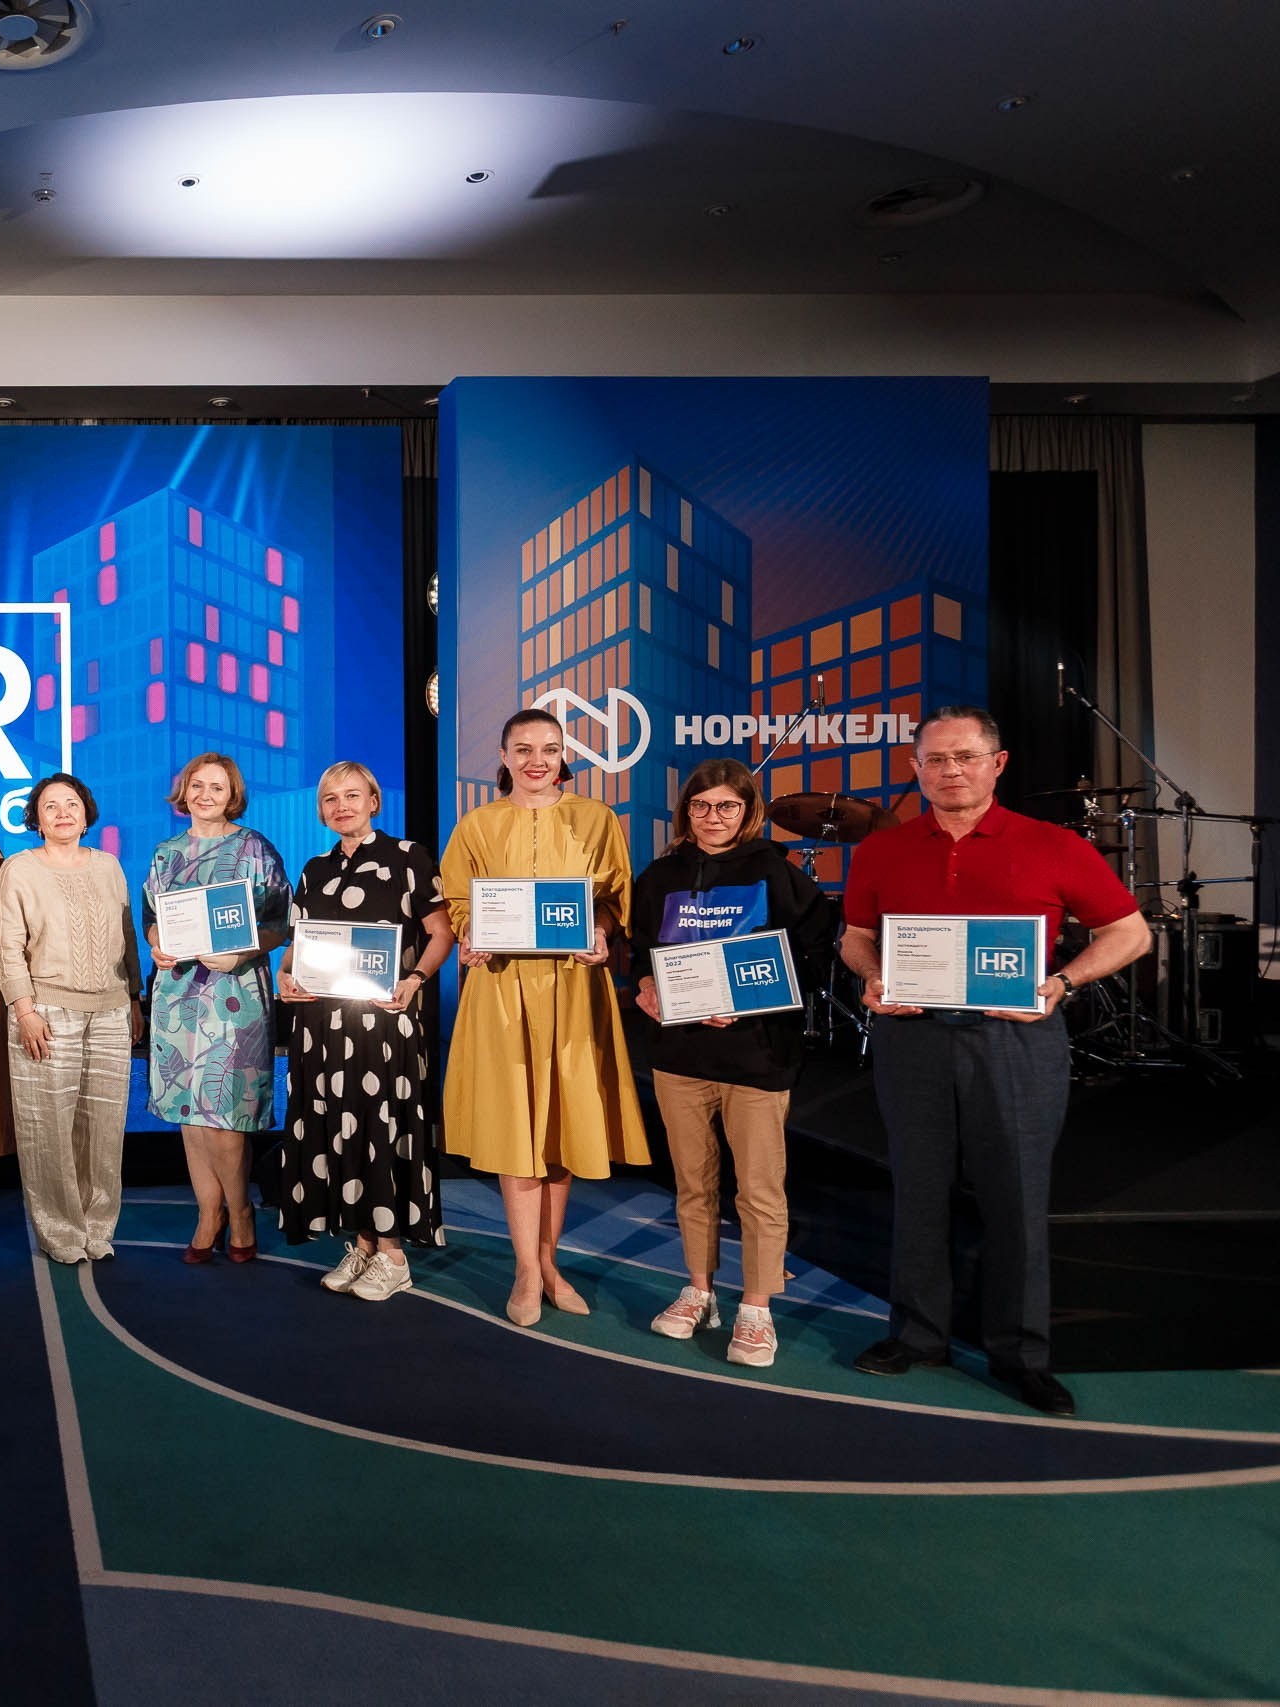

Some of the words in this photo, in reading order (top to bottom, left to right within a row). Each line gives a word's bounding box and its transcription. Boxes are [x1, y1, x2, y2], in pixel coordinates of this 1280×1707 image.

[675, 713, 918, 745] НОРНИКЕЛЬ
[217, 909, 240, 926] HR
[546, 907, 575, 922] HR
[679, 905, 697, 915] НА
[698, 905, 744, 916] ОРБИТЕ
[678, 918, 733, 929] ДОВЕРИЯ
[360, 953, 384, 970] HR
[665, 960, 682, 968] 2022
[981, 952, 1019, 971] HR
[739, 963, 772, 982] HR
